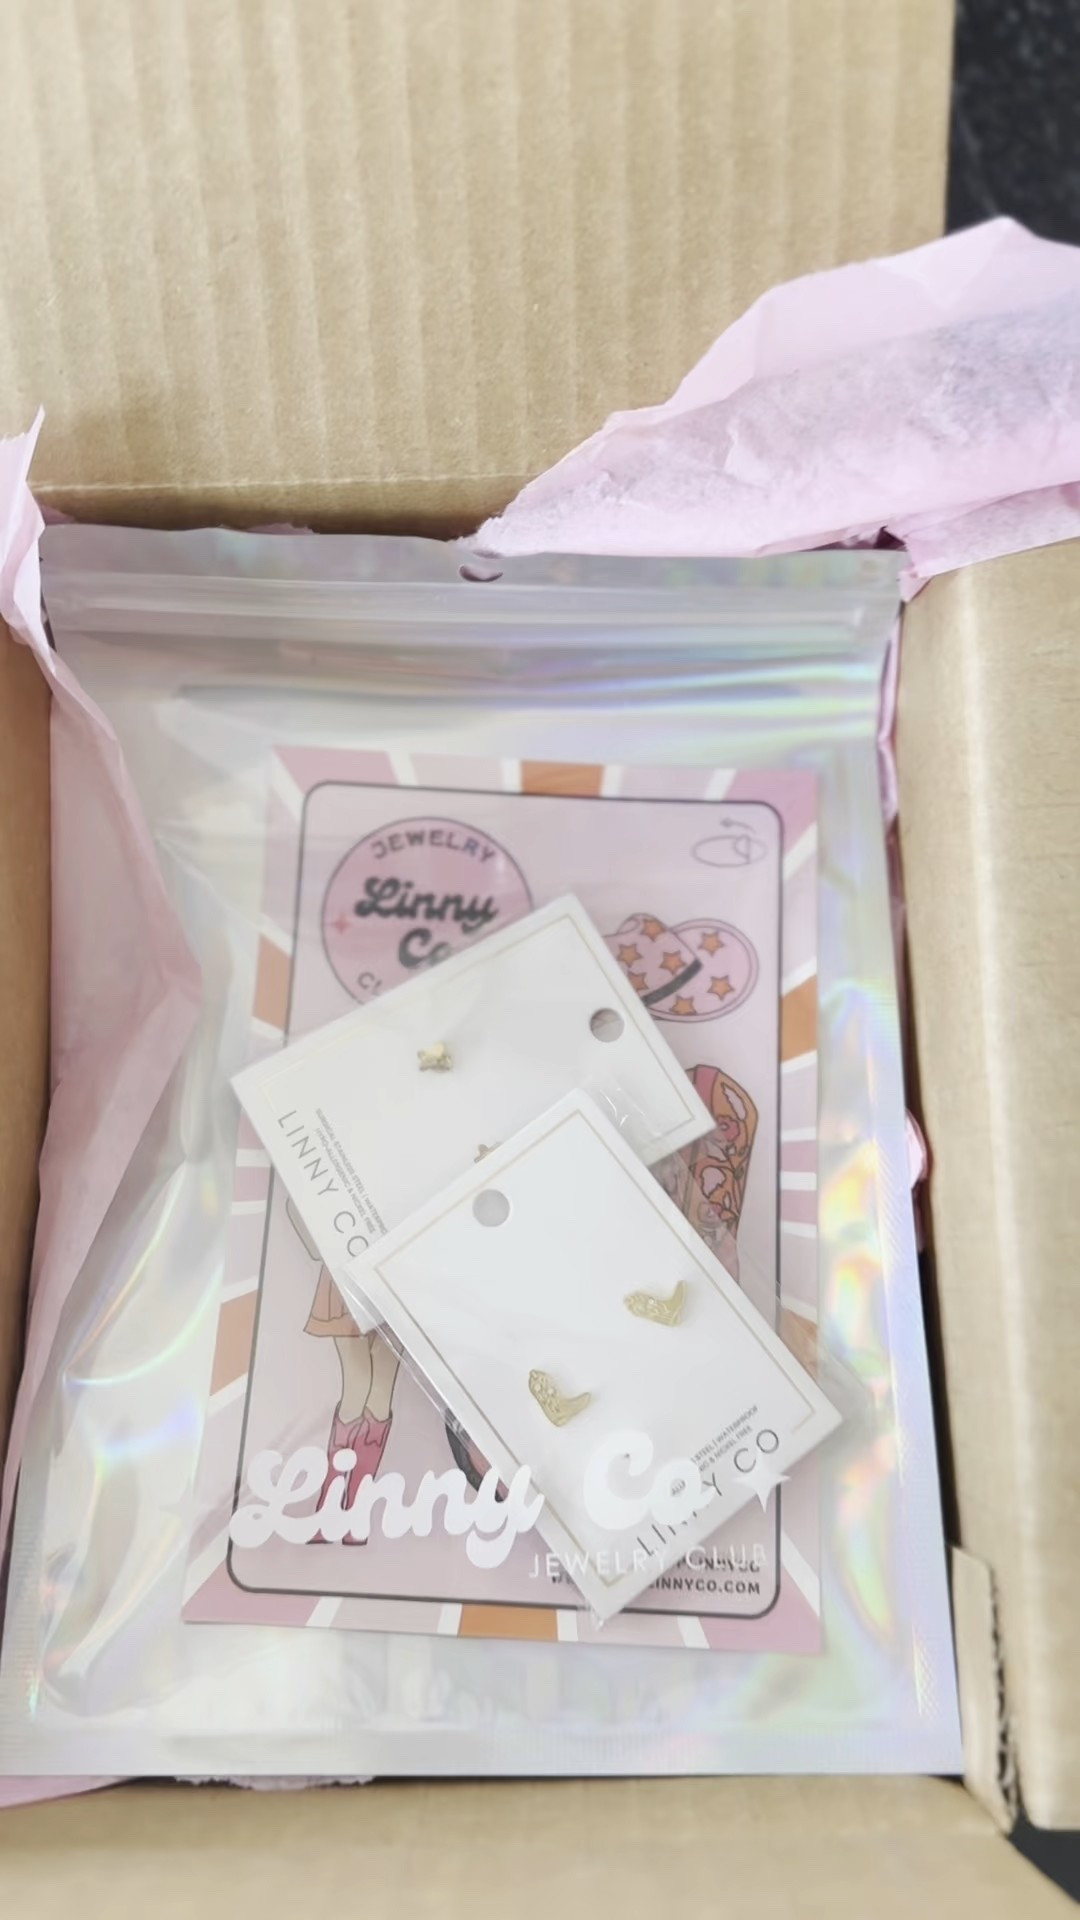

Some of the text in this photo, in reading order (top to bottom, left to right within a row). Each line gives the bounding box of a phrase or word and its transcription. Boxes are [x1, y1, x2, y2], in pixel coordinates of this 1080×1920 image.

[371, 828, 496, 863] JEWELRY
[354, 876, 498, 935] Linny
[277, 1110, 340, 1196] LINNY
[733, 1429, 779, 1473] CO
[229, 1429, 716, 1569] Linny Co
[529, 1543, 768, 1579] JEWELRY CLUB
